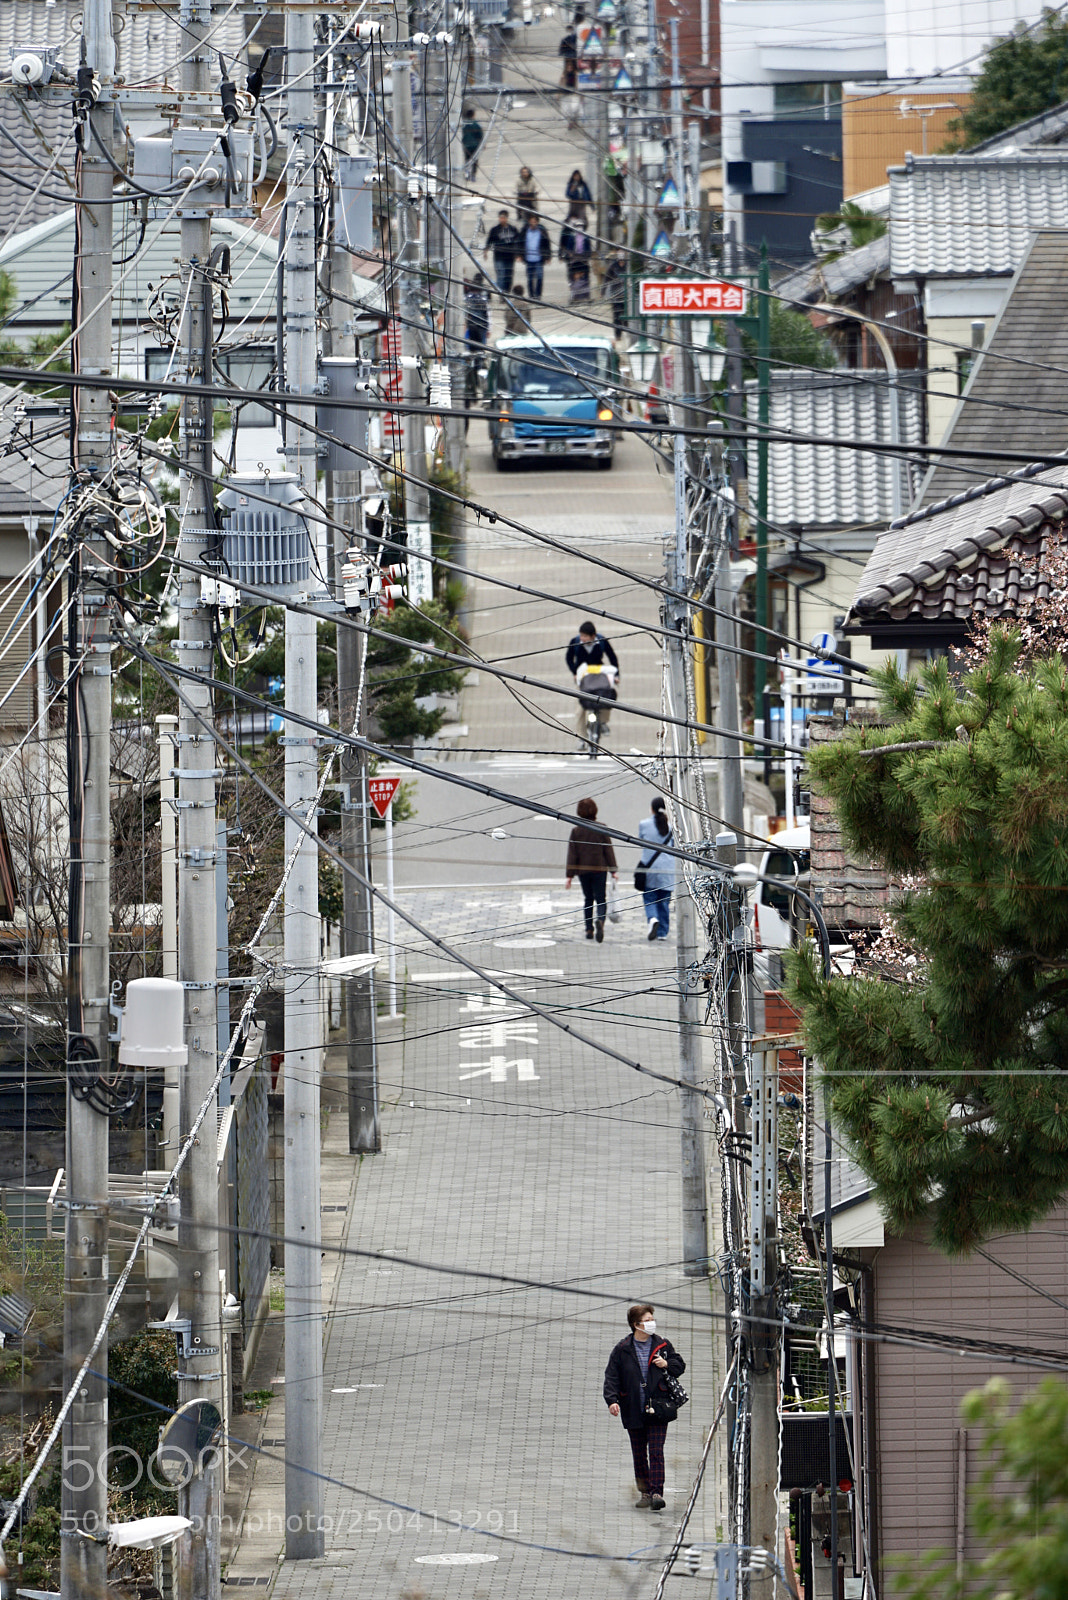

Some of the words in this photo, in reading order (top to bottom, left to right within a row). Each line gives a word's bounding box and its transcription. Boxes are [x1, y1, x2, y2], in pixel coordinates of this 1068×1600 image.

[644, 287, 741, 308] 真間大門会
[370, 782, 394, 793] 止まれ
[374, 793, 391, 801] STOP
[458, 981, 540, 1082] 止まれ
